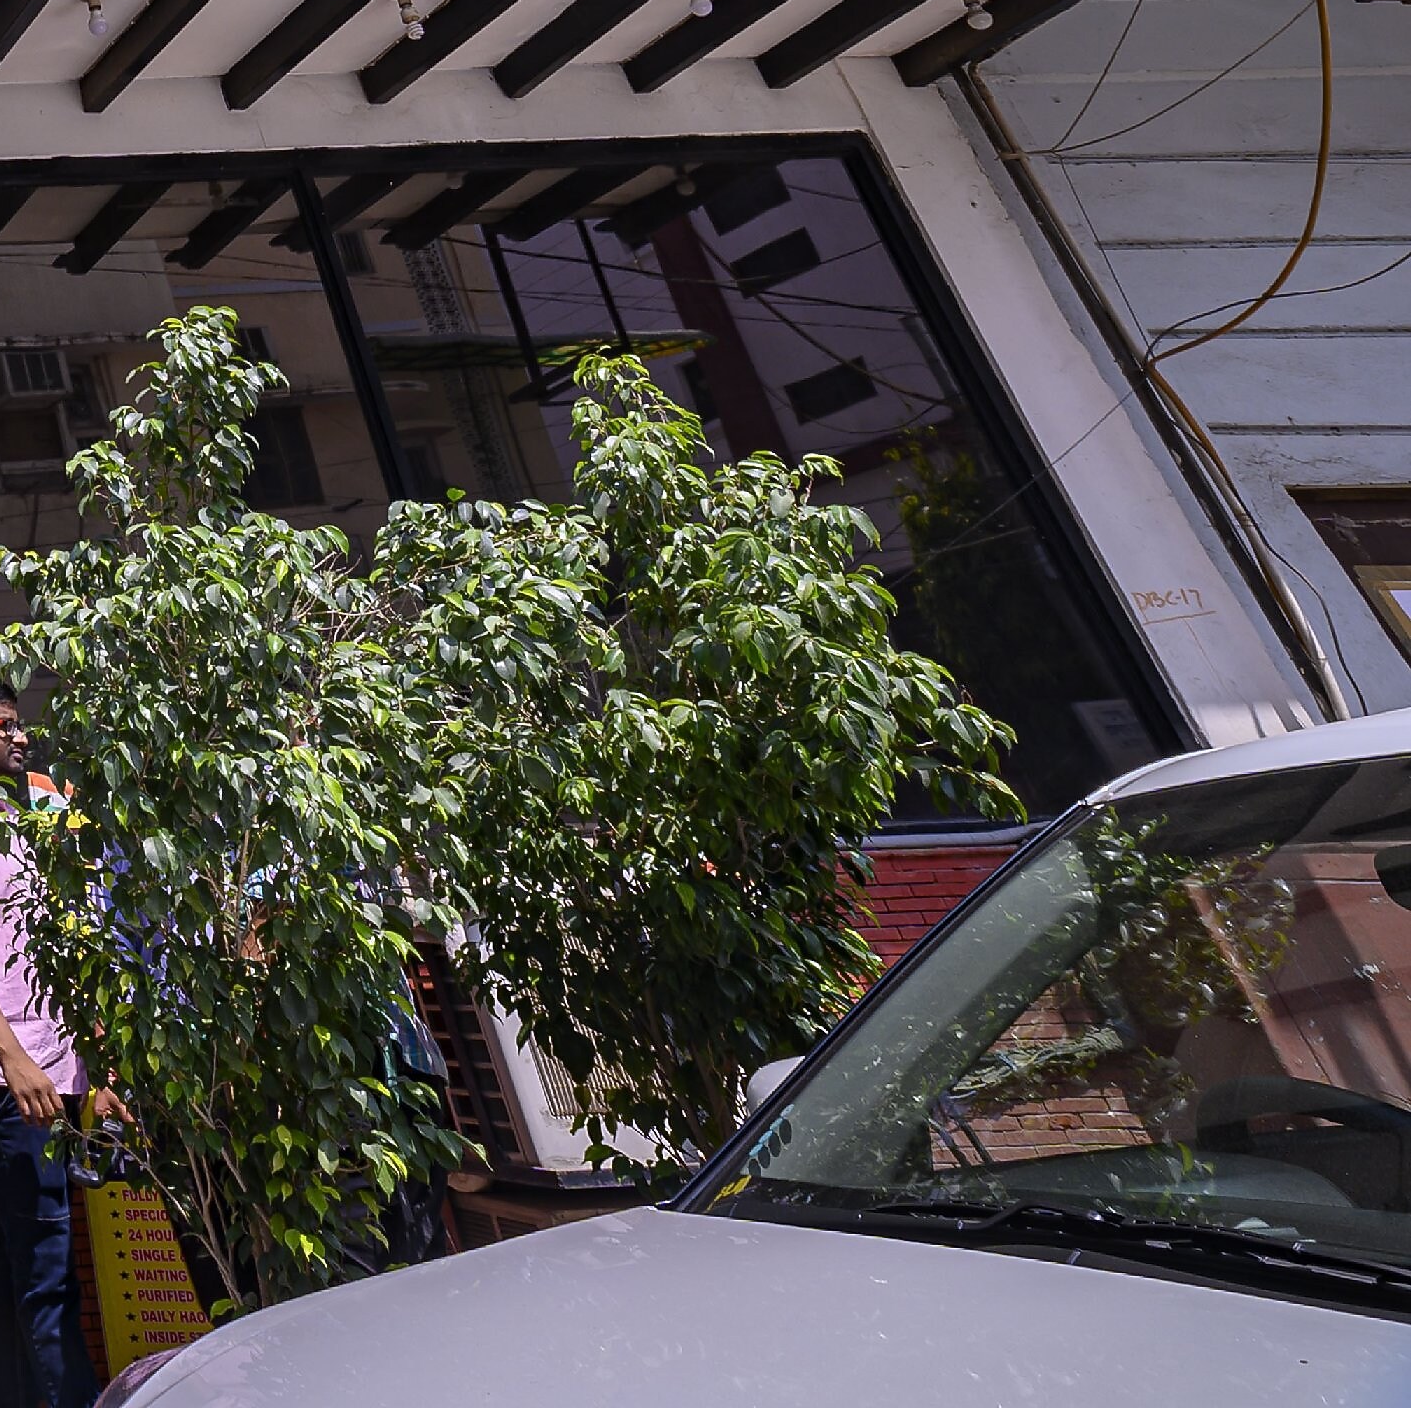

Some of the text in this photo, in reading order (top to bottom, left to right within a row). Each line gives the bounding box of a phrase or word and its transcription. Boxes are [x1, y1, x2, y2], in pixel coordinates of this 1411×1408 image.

[128, 1229, 144, 1242] 24
[131, 1249, 176, 1262] SINGLE
[134, 1269, 188, 1282] WAITING
[137, 1289, 195, 1303] PURIFIED
[140, 1310, 176, 1323] DAILY
[144, 1331, 187, 1343] INSIDE
